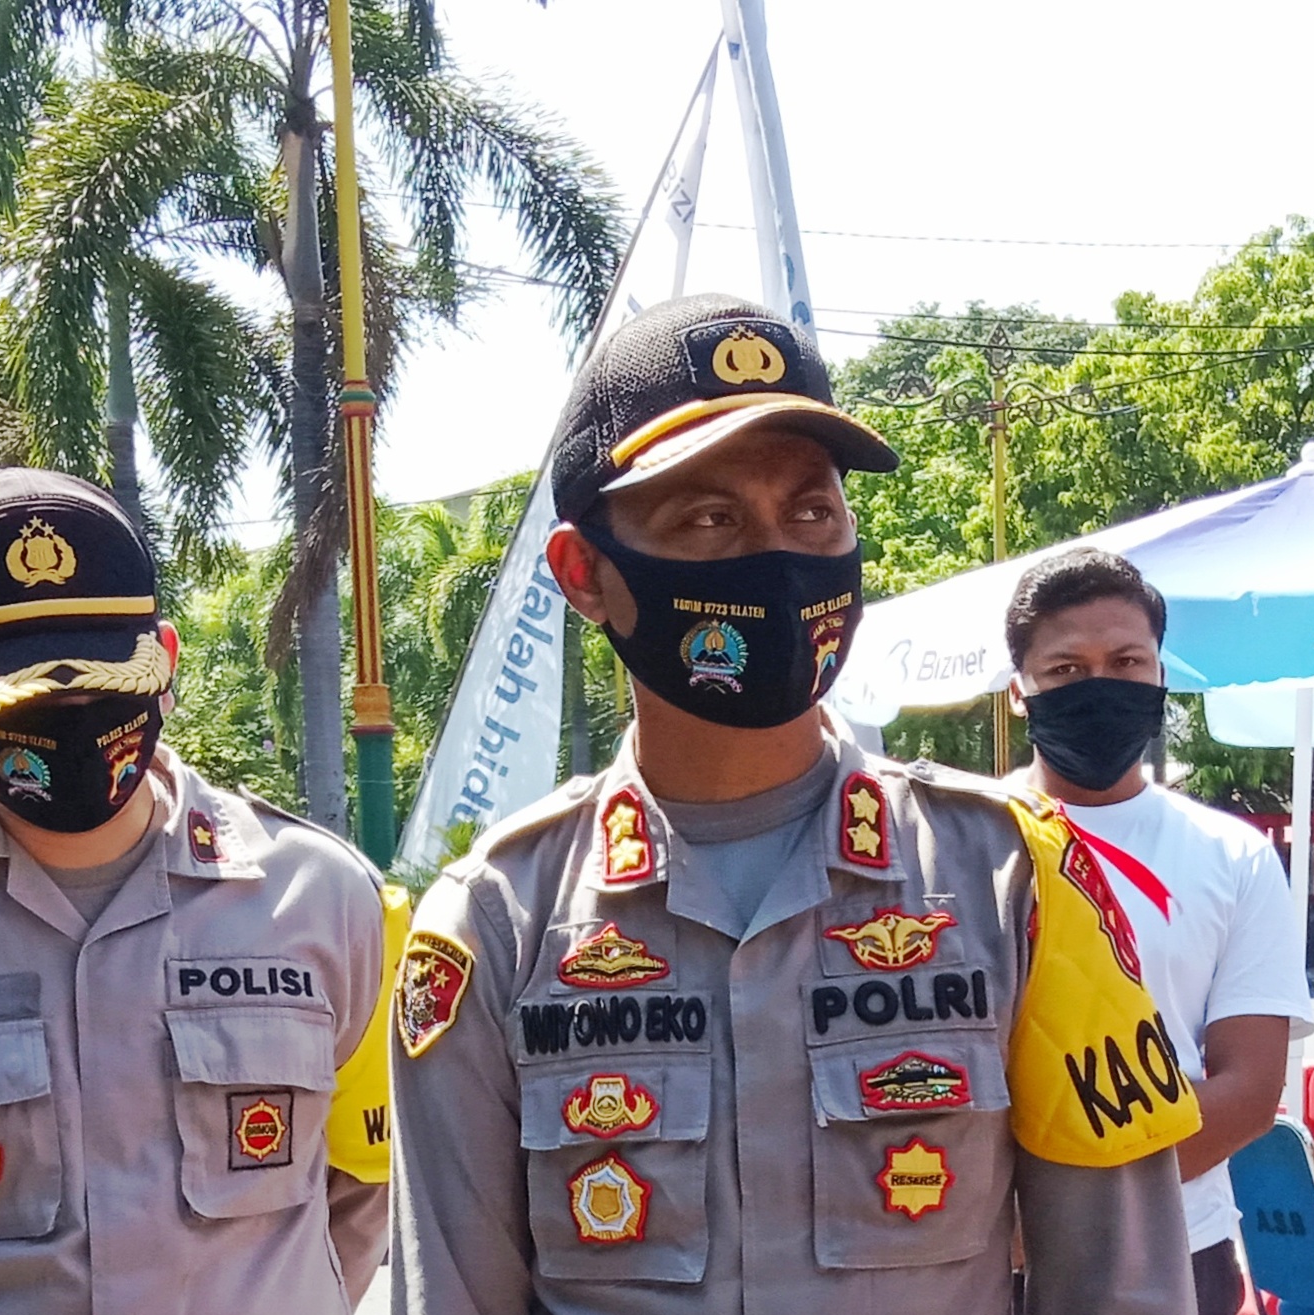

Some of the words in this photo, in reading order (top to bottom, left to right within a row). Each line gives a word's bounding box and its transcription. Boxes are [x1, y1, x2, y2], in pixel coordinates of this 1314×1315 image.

[917, 648, 987, 681] Biznet
[178, 966, 315, 998] POLISI
[811, 968, 989, 1036] POLRI
[645, 995, 707, 1043] EKO
[890, 1174, 942, 1187] RESERSE
